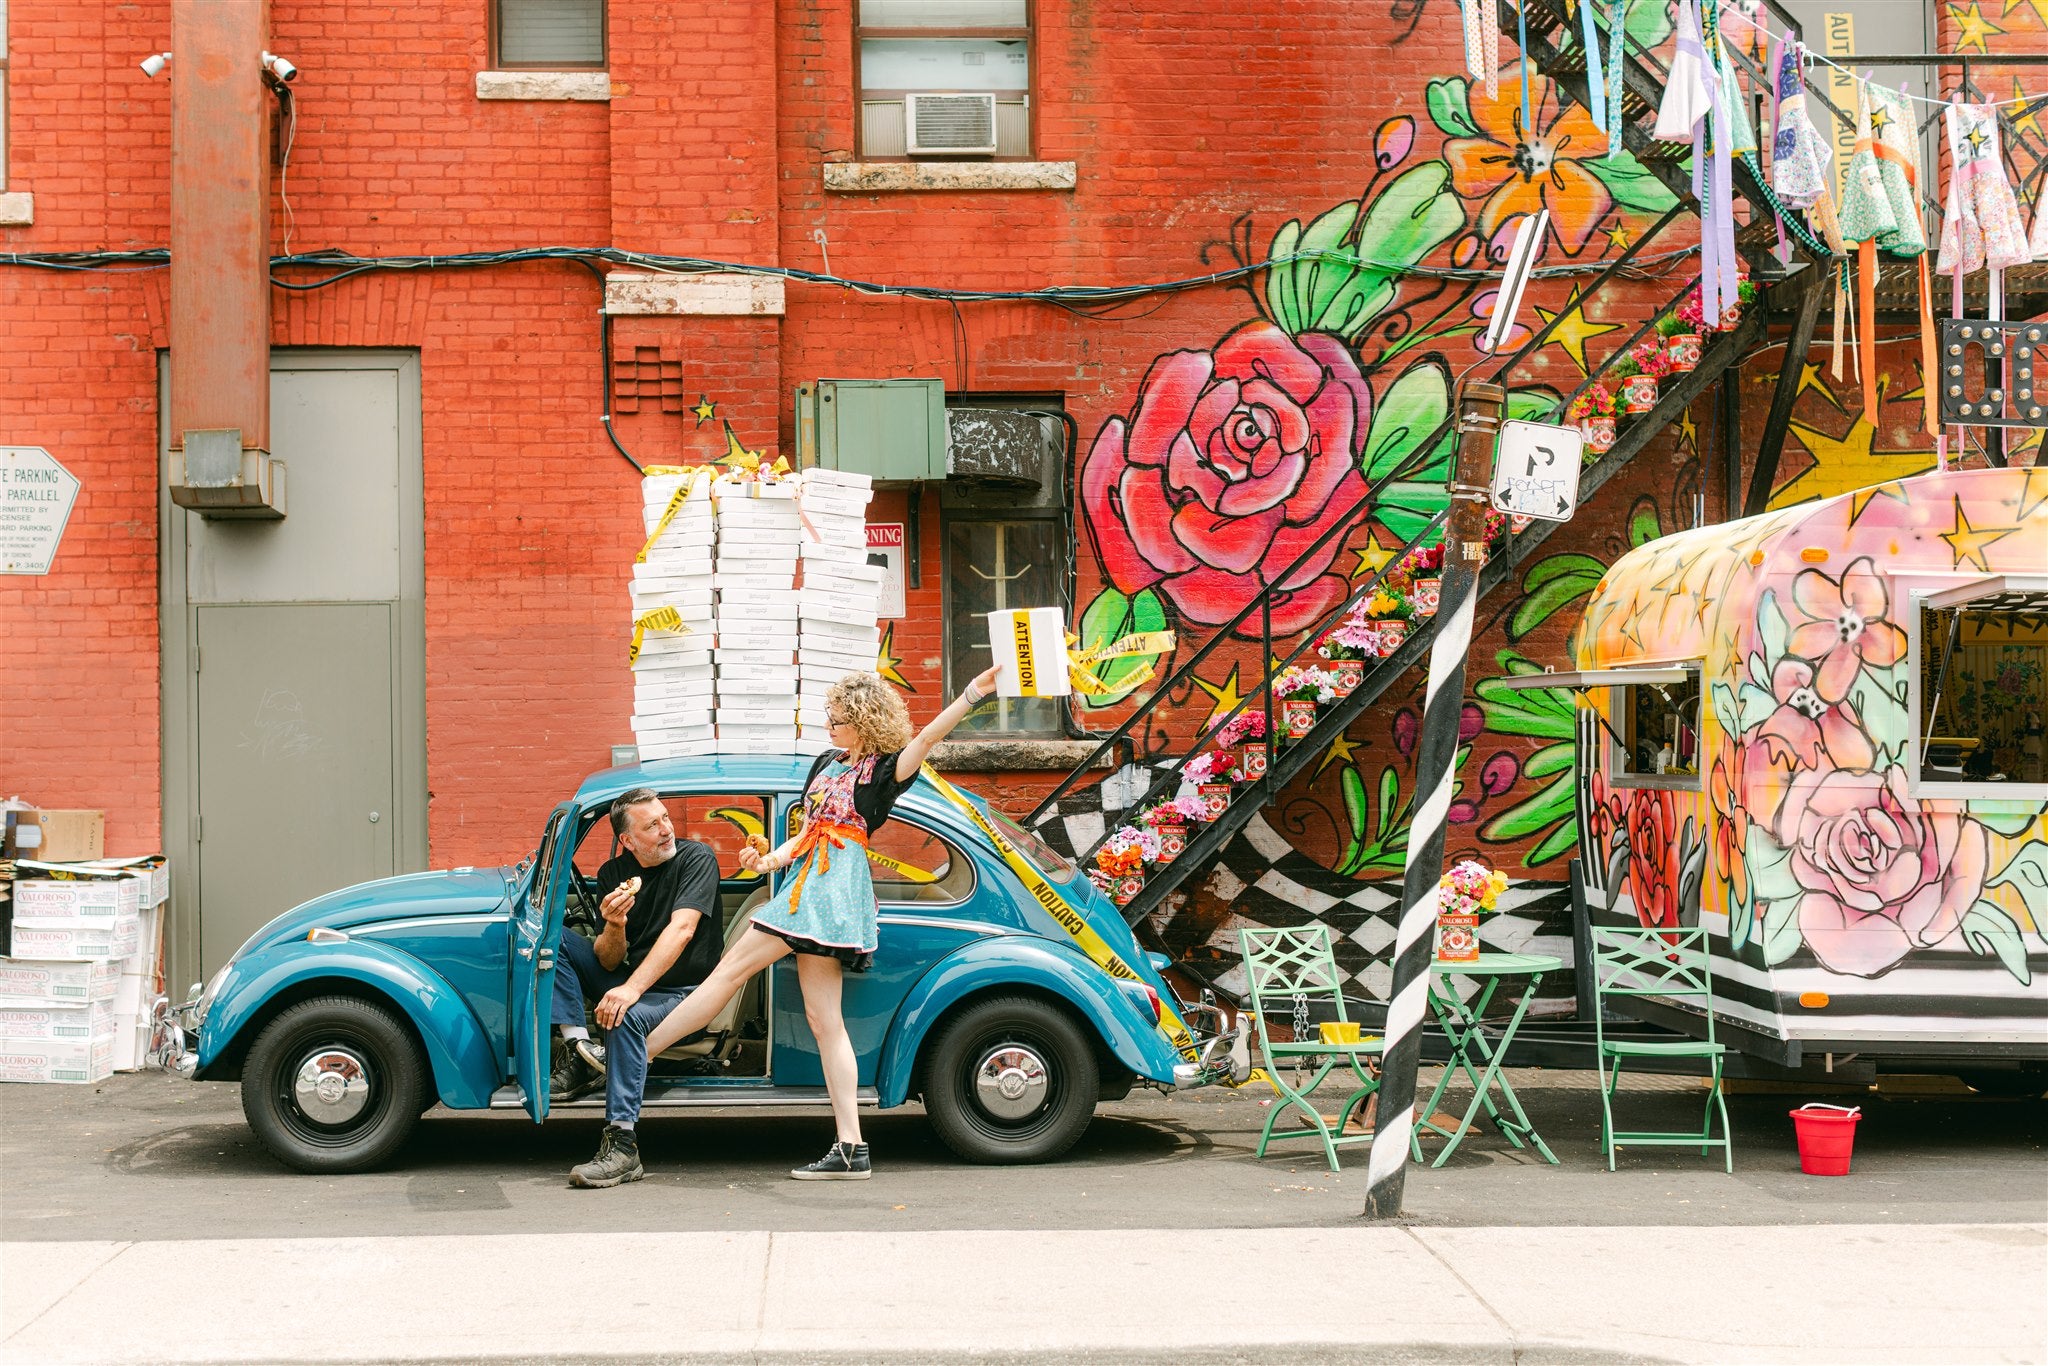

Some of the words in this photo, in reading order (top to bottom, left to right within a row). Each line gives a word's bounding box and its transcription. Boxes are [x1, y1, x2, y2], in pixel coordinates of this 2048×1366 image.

[1831, 13, 1853, 88] AUTON
[14, 468, 59, 483] PARKING
[7, 489, 60, 501] PARALLEL
[1016, 621, 1034, 687] ATTENTION
[20, 892, 72, 902] VALOROSO
[1032, 881, 1084, 935] CAUTION
[18, 931, 68, 941] VALOROSO
[0, 1012, 46, 1022] ALOROSO
[0, 1058, 43, 1066] ALOROSO
